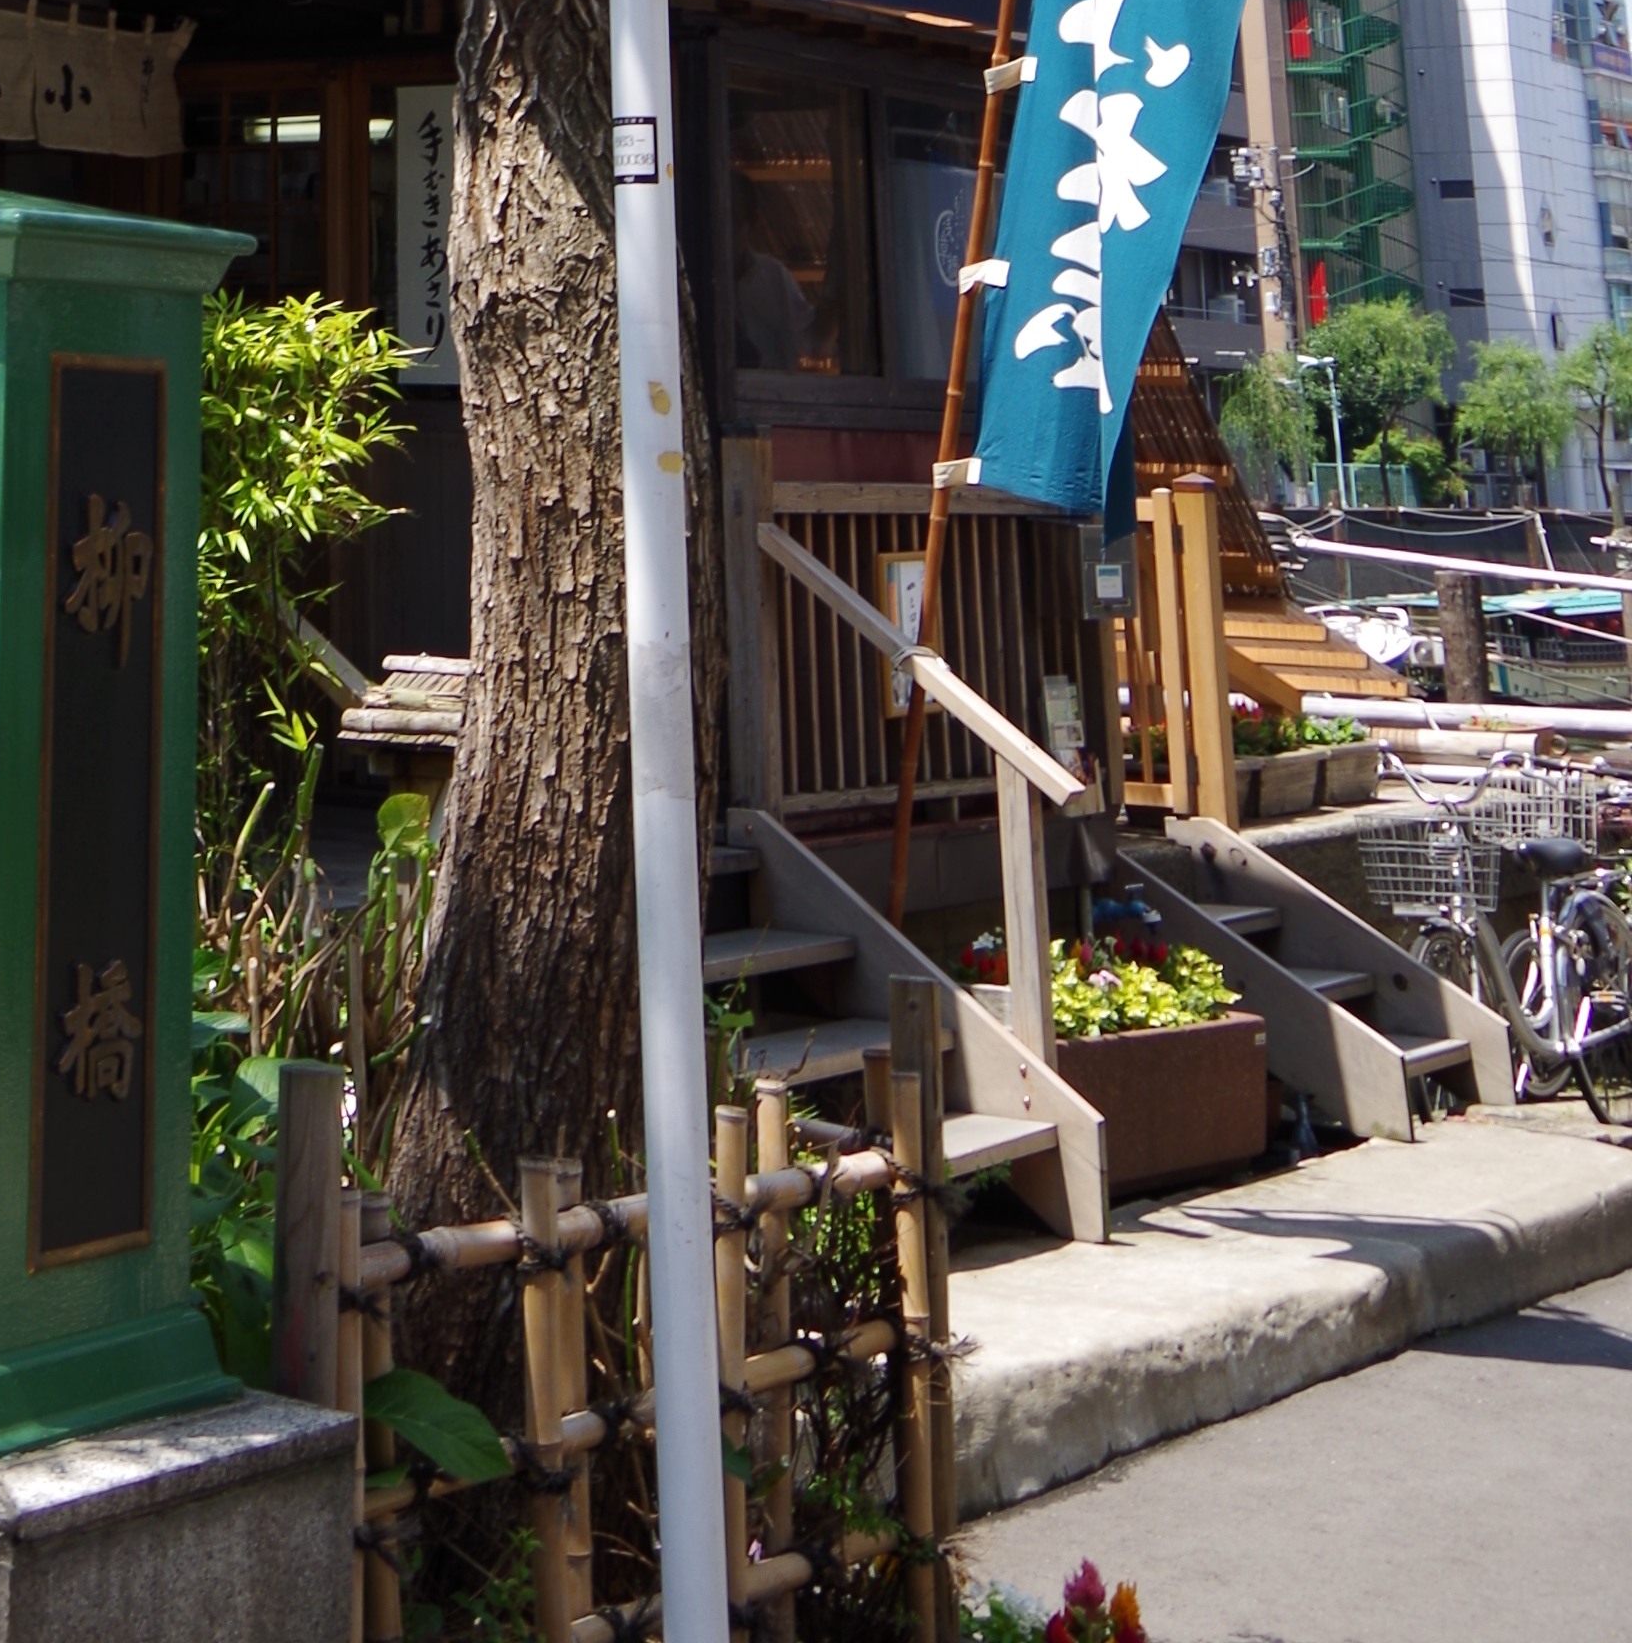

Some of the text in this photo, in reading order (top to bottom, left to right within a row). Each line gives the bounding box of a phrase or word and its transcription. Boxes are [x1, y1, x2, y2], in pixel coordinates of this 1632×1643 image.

[416, 110, 448, 364] 手むきあさり
[58, 492, 154, 1104] 柳橋
